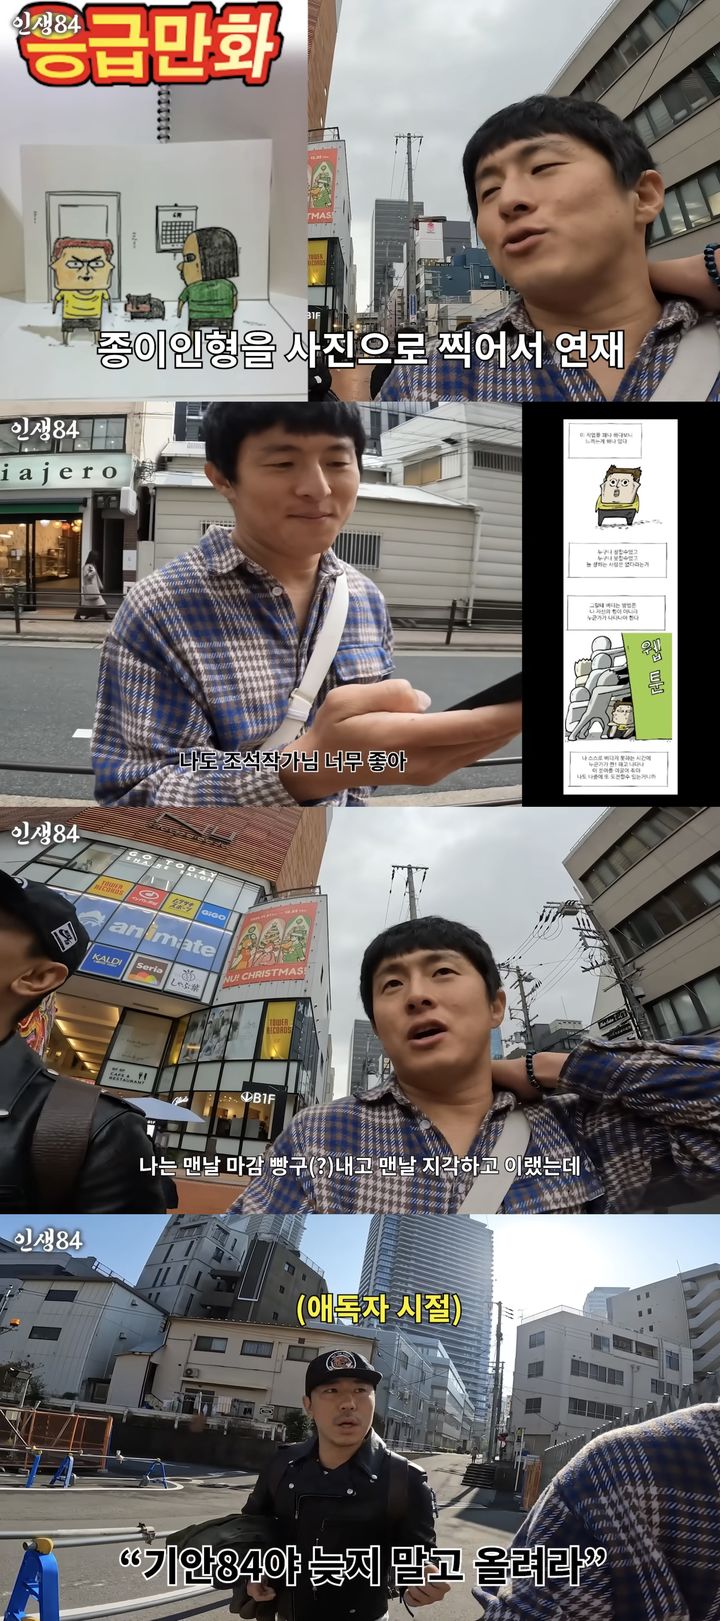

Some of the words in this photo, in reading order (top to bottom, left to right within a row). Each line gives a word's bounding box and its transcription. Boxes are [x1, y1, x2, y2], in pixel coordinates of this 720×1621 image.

[128, 851, 152, 860] GO
[165, 859, 218, 878] TODAY
[108, 921, 217, 957] animate
[92, 953, 123, 966] KALDI
[136, 962, 163, 974] Seria
[253, 1093, 276, 1104] B1F
